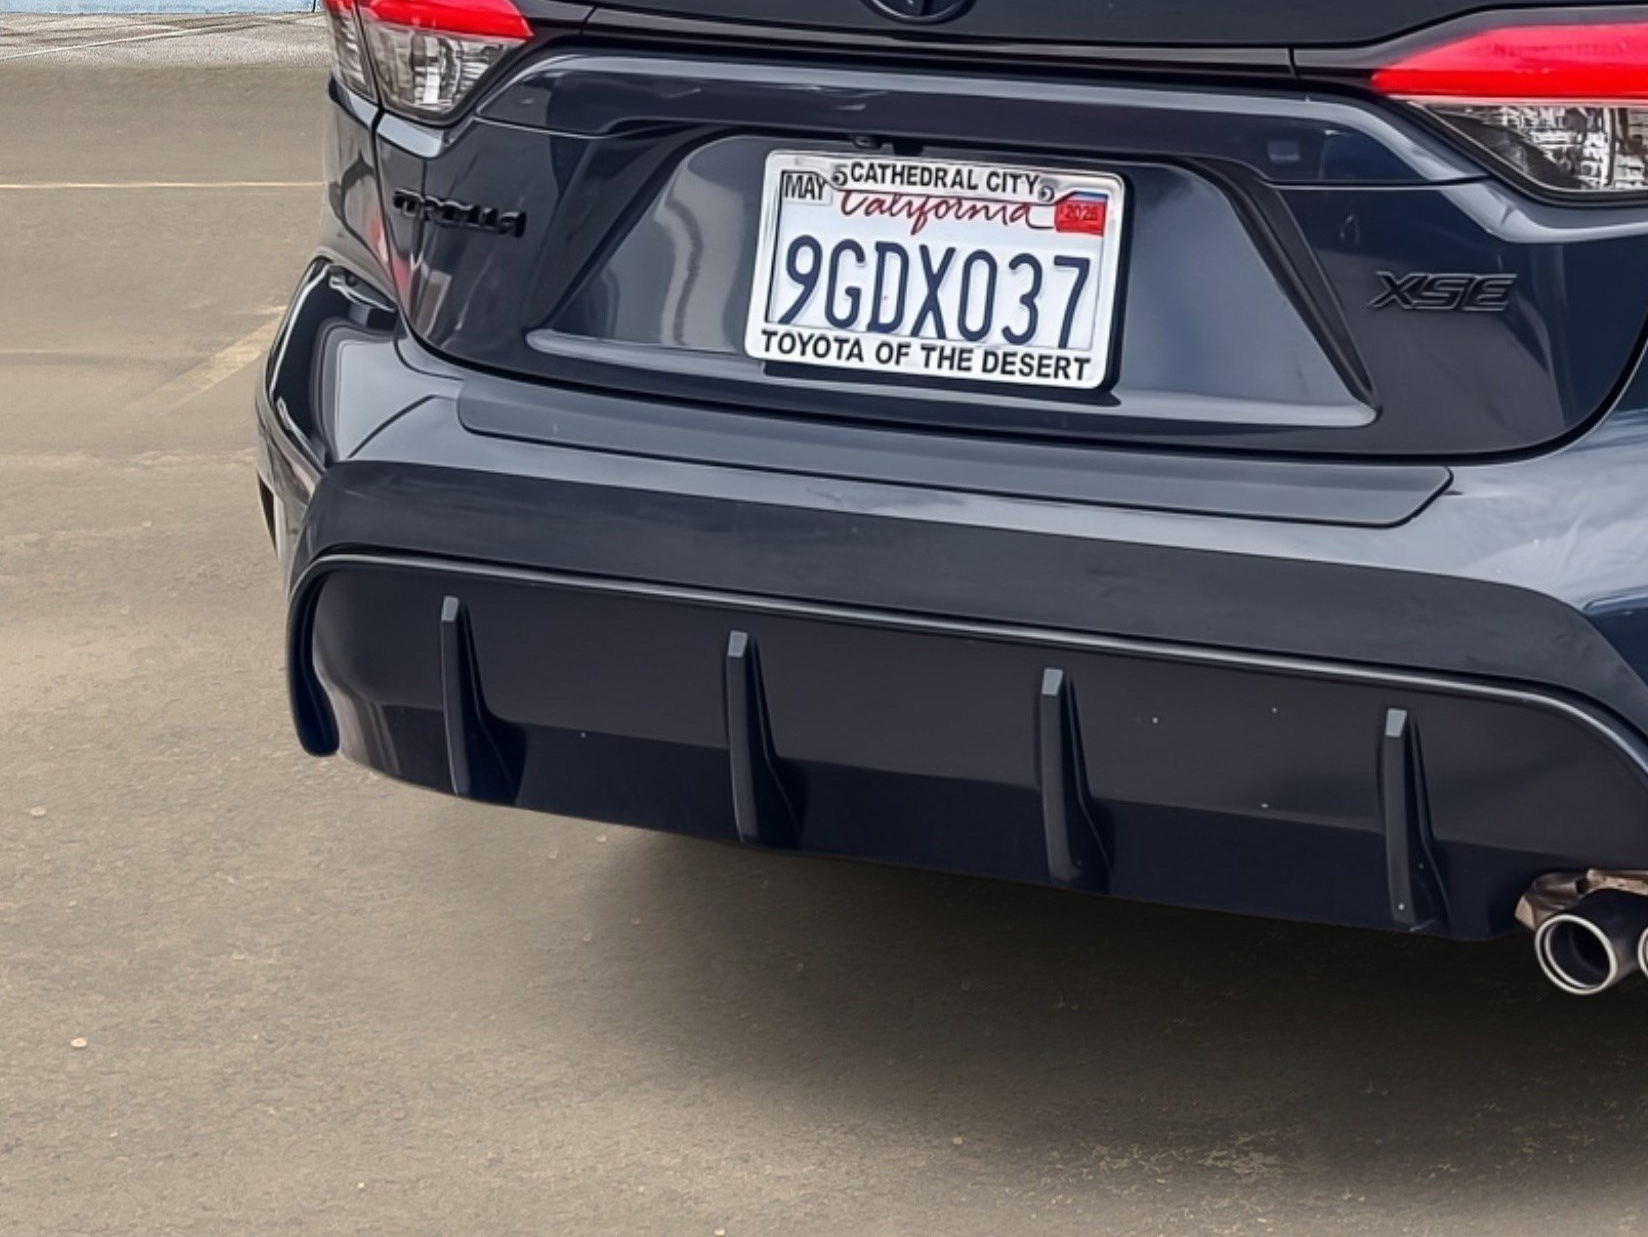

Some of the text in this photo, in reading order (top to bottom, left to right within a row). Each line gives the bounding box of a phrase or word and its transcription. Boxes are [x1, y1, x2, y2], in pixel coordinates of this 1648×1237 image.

[784, 173, 827, 200] MAY
[850, 161, 1040, 196] CATHEDRAL CITY
[840, 191, 1055, 236] California
[777, 234, 1091, 350] 9GDX037
[1367, 271, 1519, 312] XSE
[761, 328, 1092, 381] TOYOTA OF THE DESERT
